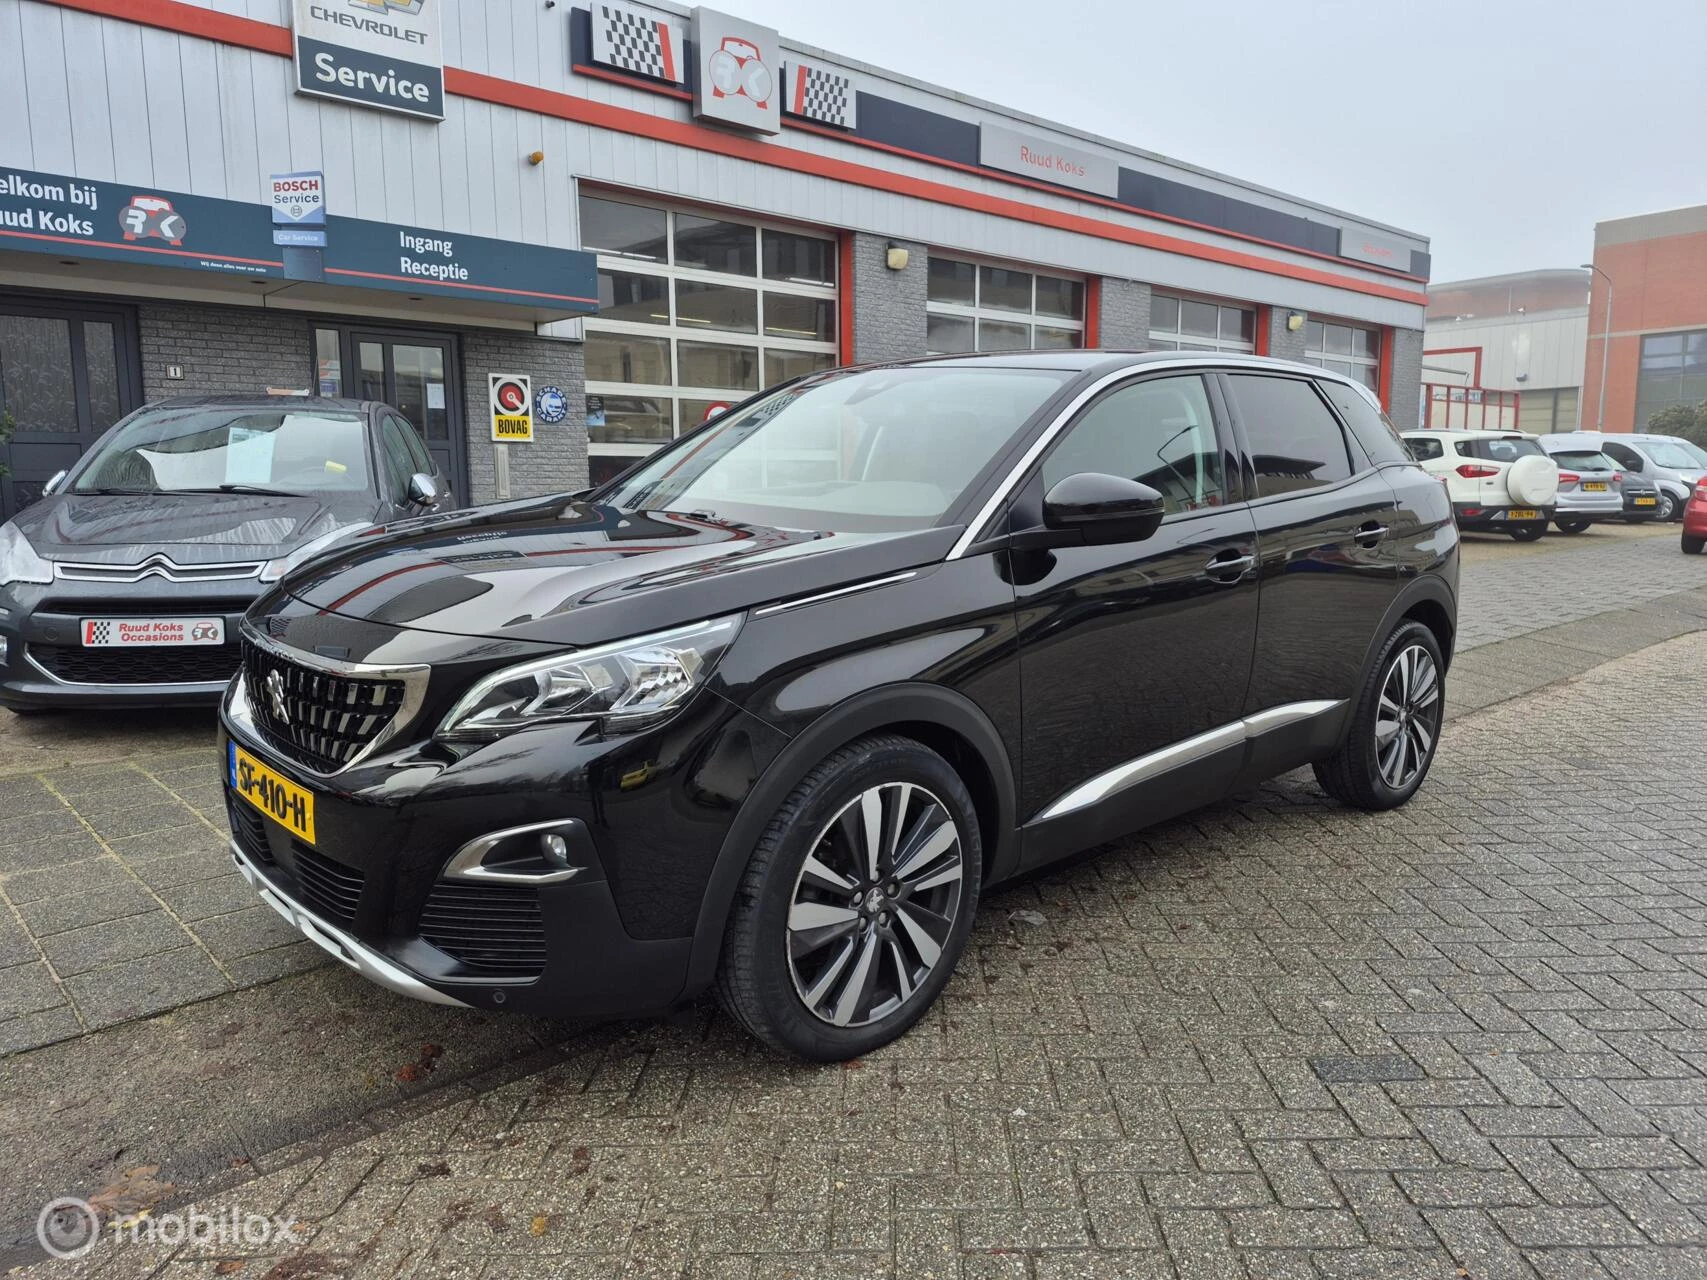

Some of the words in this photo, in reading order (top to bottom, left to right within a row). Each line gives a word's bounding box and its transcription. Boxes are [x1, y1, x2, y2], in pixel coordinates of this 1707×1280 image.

[310, 5, 428, 45] CHEVROLET
[314, 52, 430, 103] Service
[1020, 145, 1053, 169] Ruud
[1056, 154, 1086, 177] Koks
[69, 183, 98, 211] bij
[273, 180, 319, 192] BOSCH
[274, 193, 320, 204] Service
[38, 210, 95, 236] Koks
[400, 231, 453, 257] Ingang
[400, 256, 468, 280] Receptie
[498, 419, 528, 434] BOVAG
[119, 623, 151, 632] Ruud
[153, 622, 184, 632] Koks
[121, 632, 184, 642] Occasions
[239, 758, 306, 832] SF-410-H
